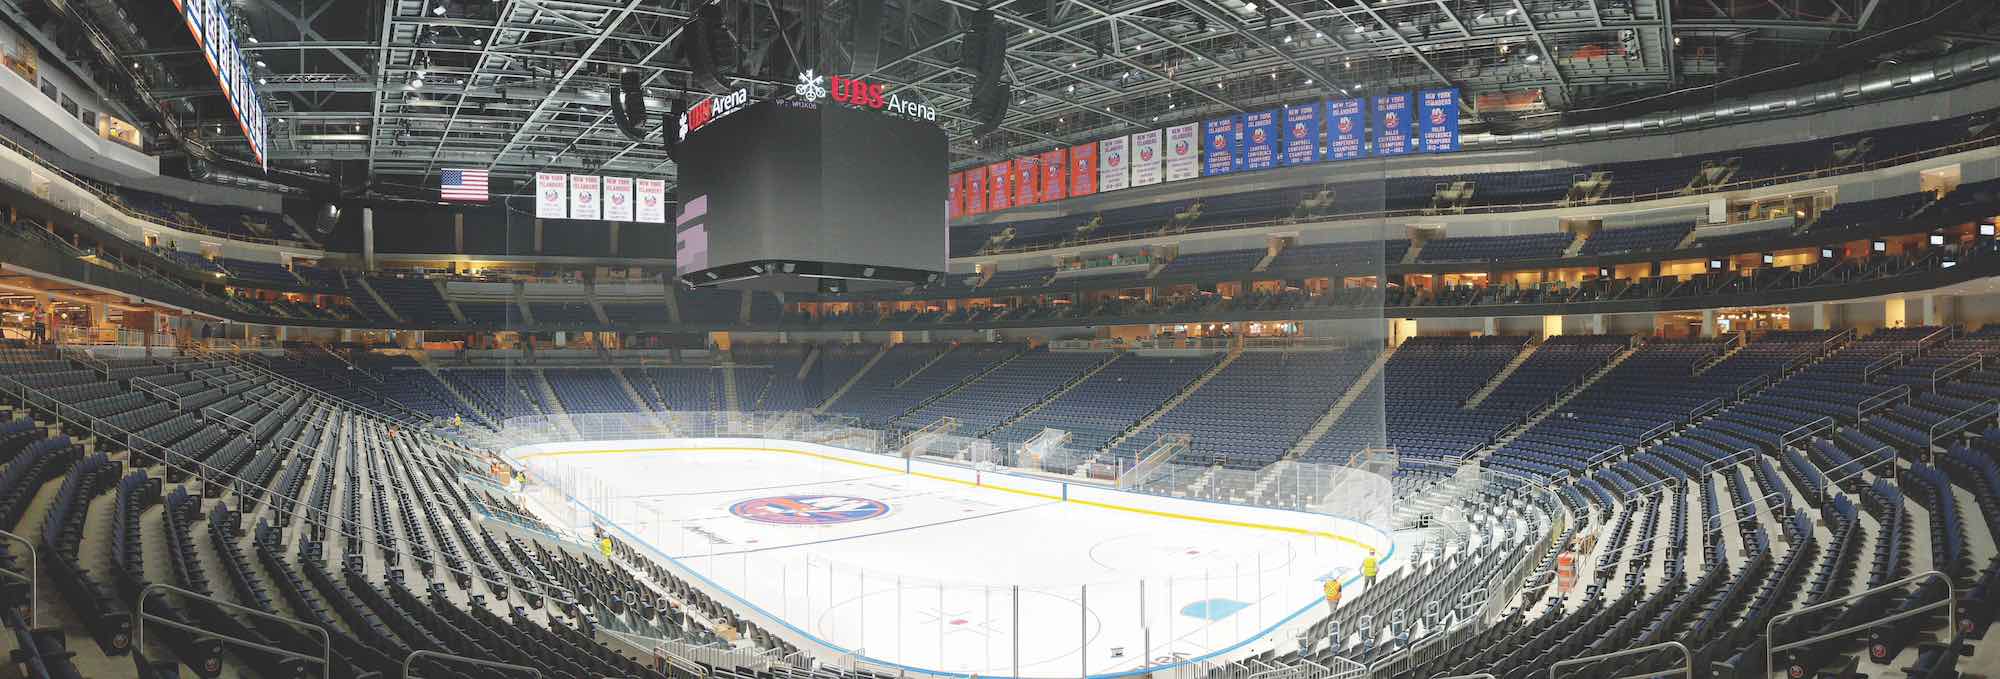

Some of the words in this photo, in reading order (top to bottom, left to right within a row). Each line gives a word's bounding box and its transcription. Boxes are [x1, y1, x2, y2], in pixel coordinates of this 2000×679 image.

[712, 88, 747, 117] Arena
[831, 75, 886, 109] UBS
[887, 93, 935, 121] Arena
